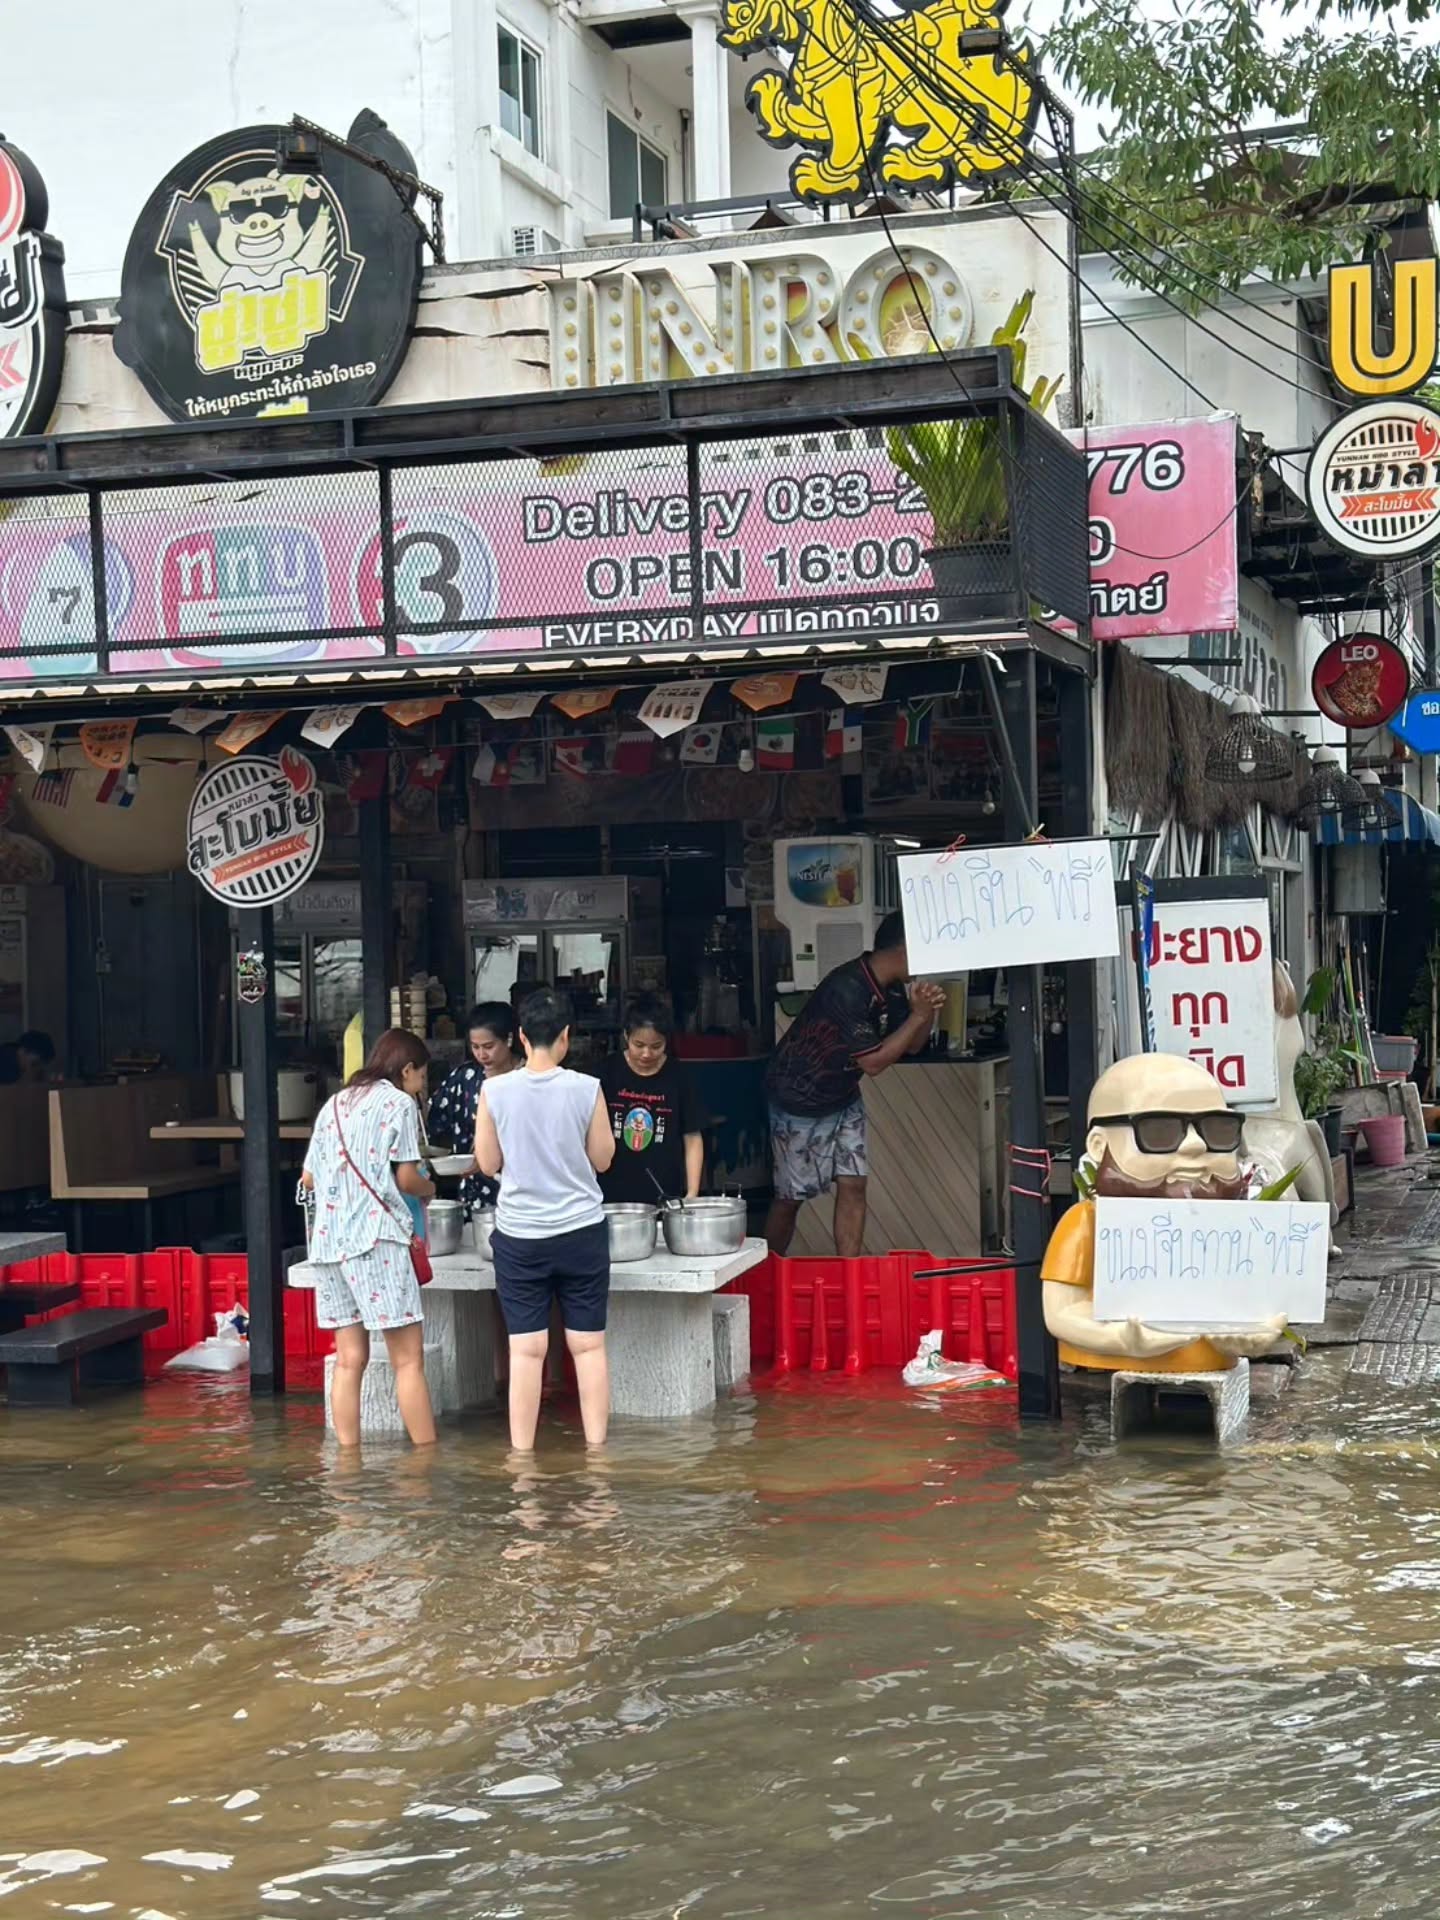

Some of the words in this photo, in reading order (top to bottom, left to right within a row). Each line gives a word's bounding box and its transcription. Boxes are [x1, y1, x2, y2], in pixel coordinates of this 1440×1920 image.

[185, 361, 377, 417] ให้หมูกระทะให้กำลังใจเธอ
[1391, 449, 1418, 457] STYLE
[522, 489, 751, 543] Delivery
[585, 549, 743, 601] OPEN
[544, 611, 745, 648] EVERYDAY
[1340, 645, 1380, 663] LEO
[1171, 990, 1230, 1038] ทุก
